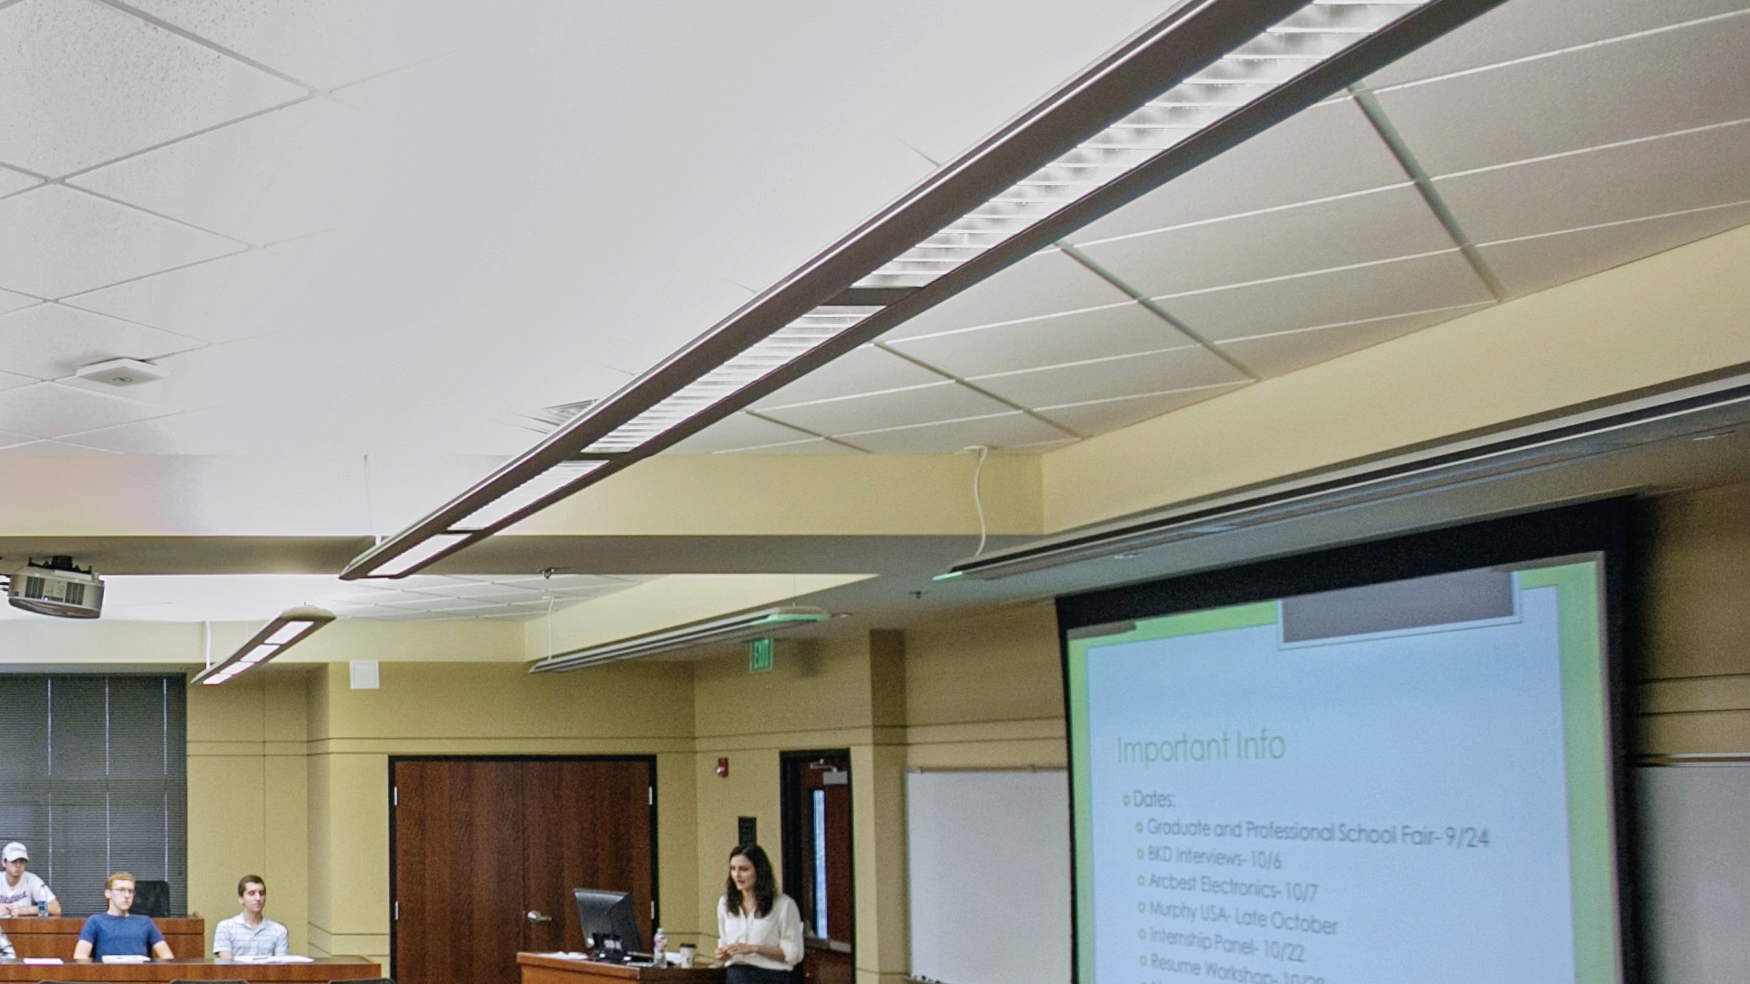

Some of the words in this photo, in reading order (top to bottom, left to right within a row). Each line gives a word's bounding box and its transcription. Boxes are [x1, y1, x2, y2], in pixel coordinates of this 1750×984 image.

[1117, 732, 1230, 769] Important
[1237, 728, 1287, 761] Info
[1134, 790, 1176, 808] Dates:
[1148, 818, 1211, 837] Graduate
[1214, 821, 1242, 838] and
[1246, 821, 1334, 841] Professional
[1338, 823, 1396, 844] School
[1402, 825, 1441, 845] Fair-
[1445, 826, 1490, 848] 9/24
[1148, 845, 1173, 863] BKD
[1176, 848, 1246, 867] Interviews-
[1251, 851, 1283, 871] 10/6
[1149, 873, 1197, 891] Arcbest
[1201, 875, 1282, 898] Electronics-
[1286, 881, 1319, 903] 10/7
[1150, 901, 1197, 923] Murphy
[1201, 903, 1231, 922] USA-
[1235, 907, 1267, 927] Late
[1271, 910, 1339, 936] October
[1151, 927, 1212, 952] Internship
[1215, 934, 1260, 955] Panel-
[1263, 940, 1305, 963] 10/22
[1151, 952, 1201, 976] Resume
